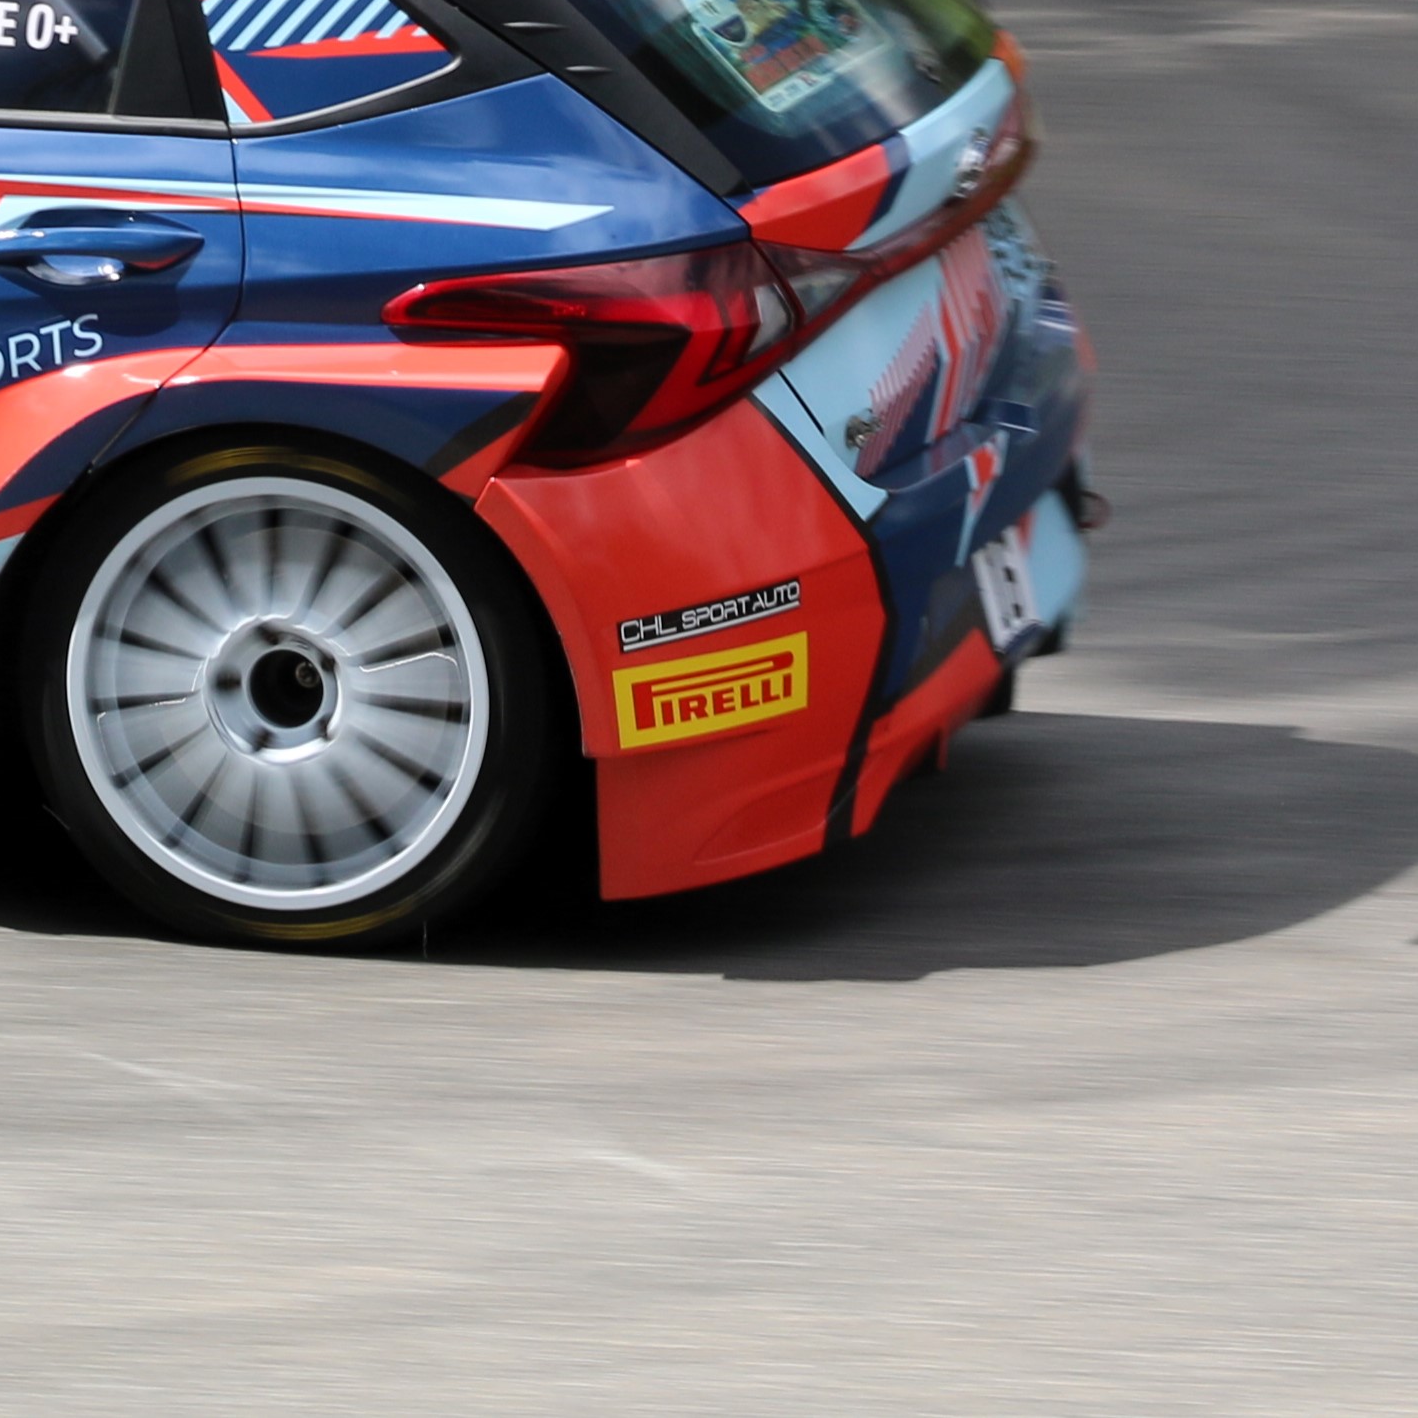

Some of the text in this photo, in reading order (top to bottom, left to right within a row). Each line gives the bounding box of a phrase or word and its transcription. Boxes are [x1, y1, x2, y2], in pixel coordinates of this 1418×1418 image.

[620, 581, 800, 645] CHL SPORT AUTO
[631, 651, 794, 730] PIRELLI
